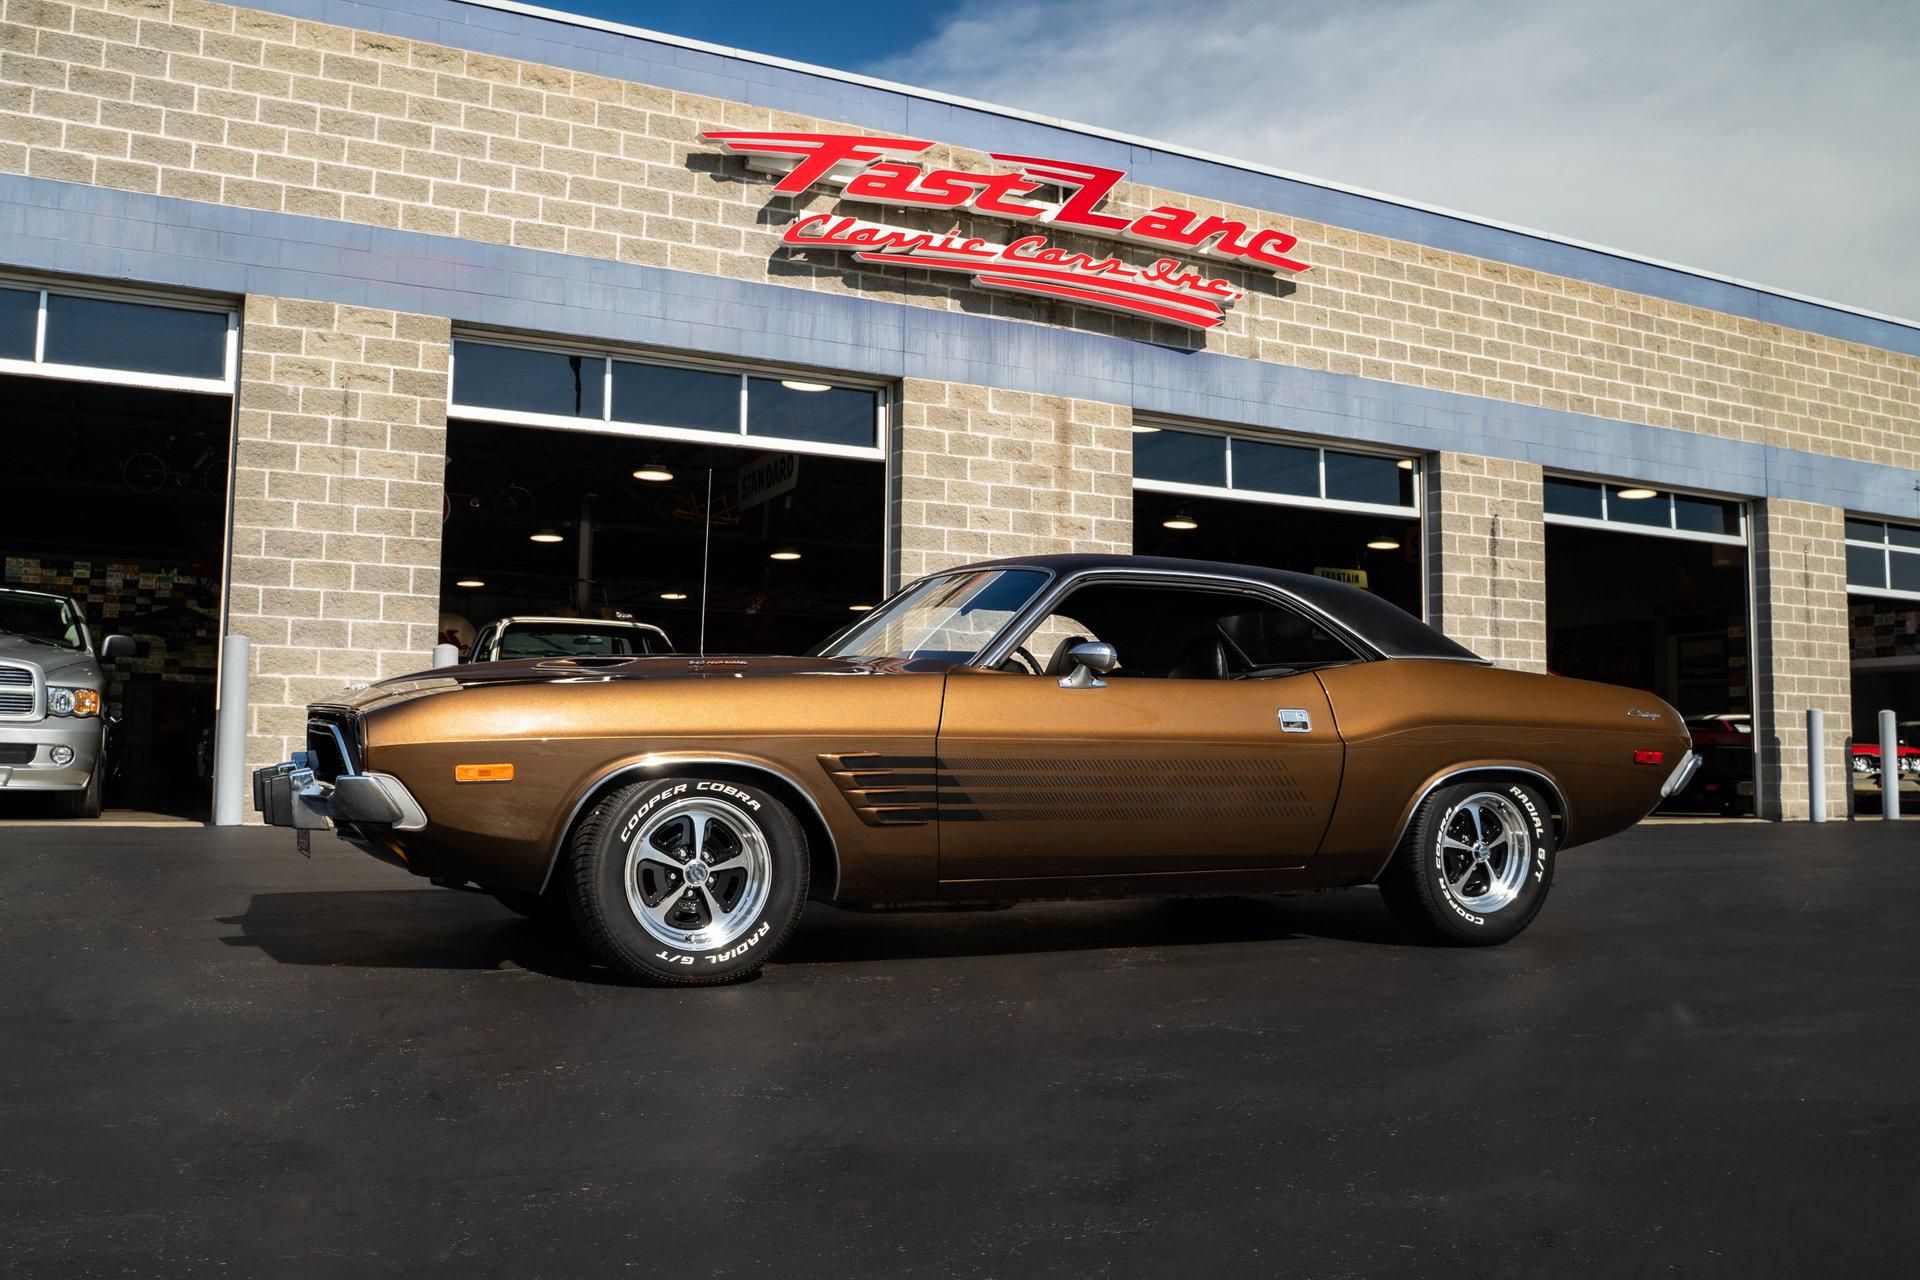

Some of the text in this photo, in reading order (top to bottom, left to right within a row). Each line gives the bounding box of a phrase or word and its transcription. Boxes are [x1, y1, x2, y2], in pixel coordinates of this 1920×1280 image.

[701, 131, 1314, 273] Fast Lane
[783, 213, 998, 257] Classic
[1002, 236, 1137, 277] Cars
[742, 454, 794, 500] STANDARD
[621, 781, 761, 843] COOPER COBRA
[1509, 785, 1546, 882] RADIAL G/T
[1435, 807, 1485, 925] COOPER COBRA
[656, 921, 770, 965] RADIAL G/T
